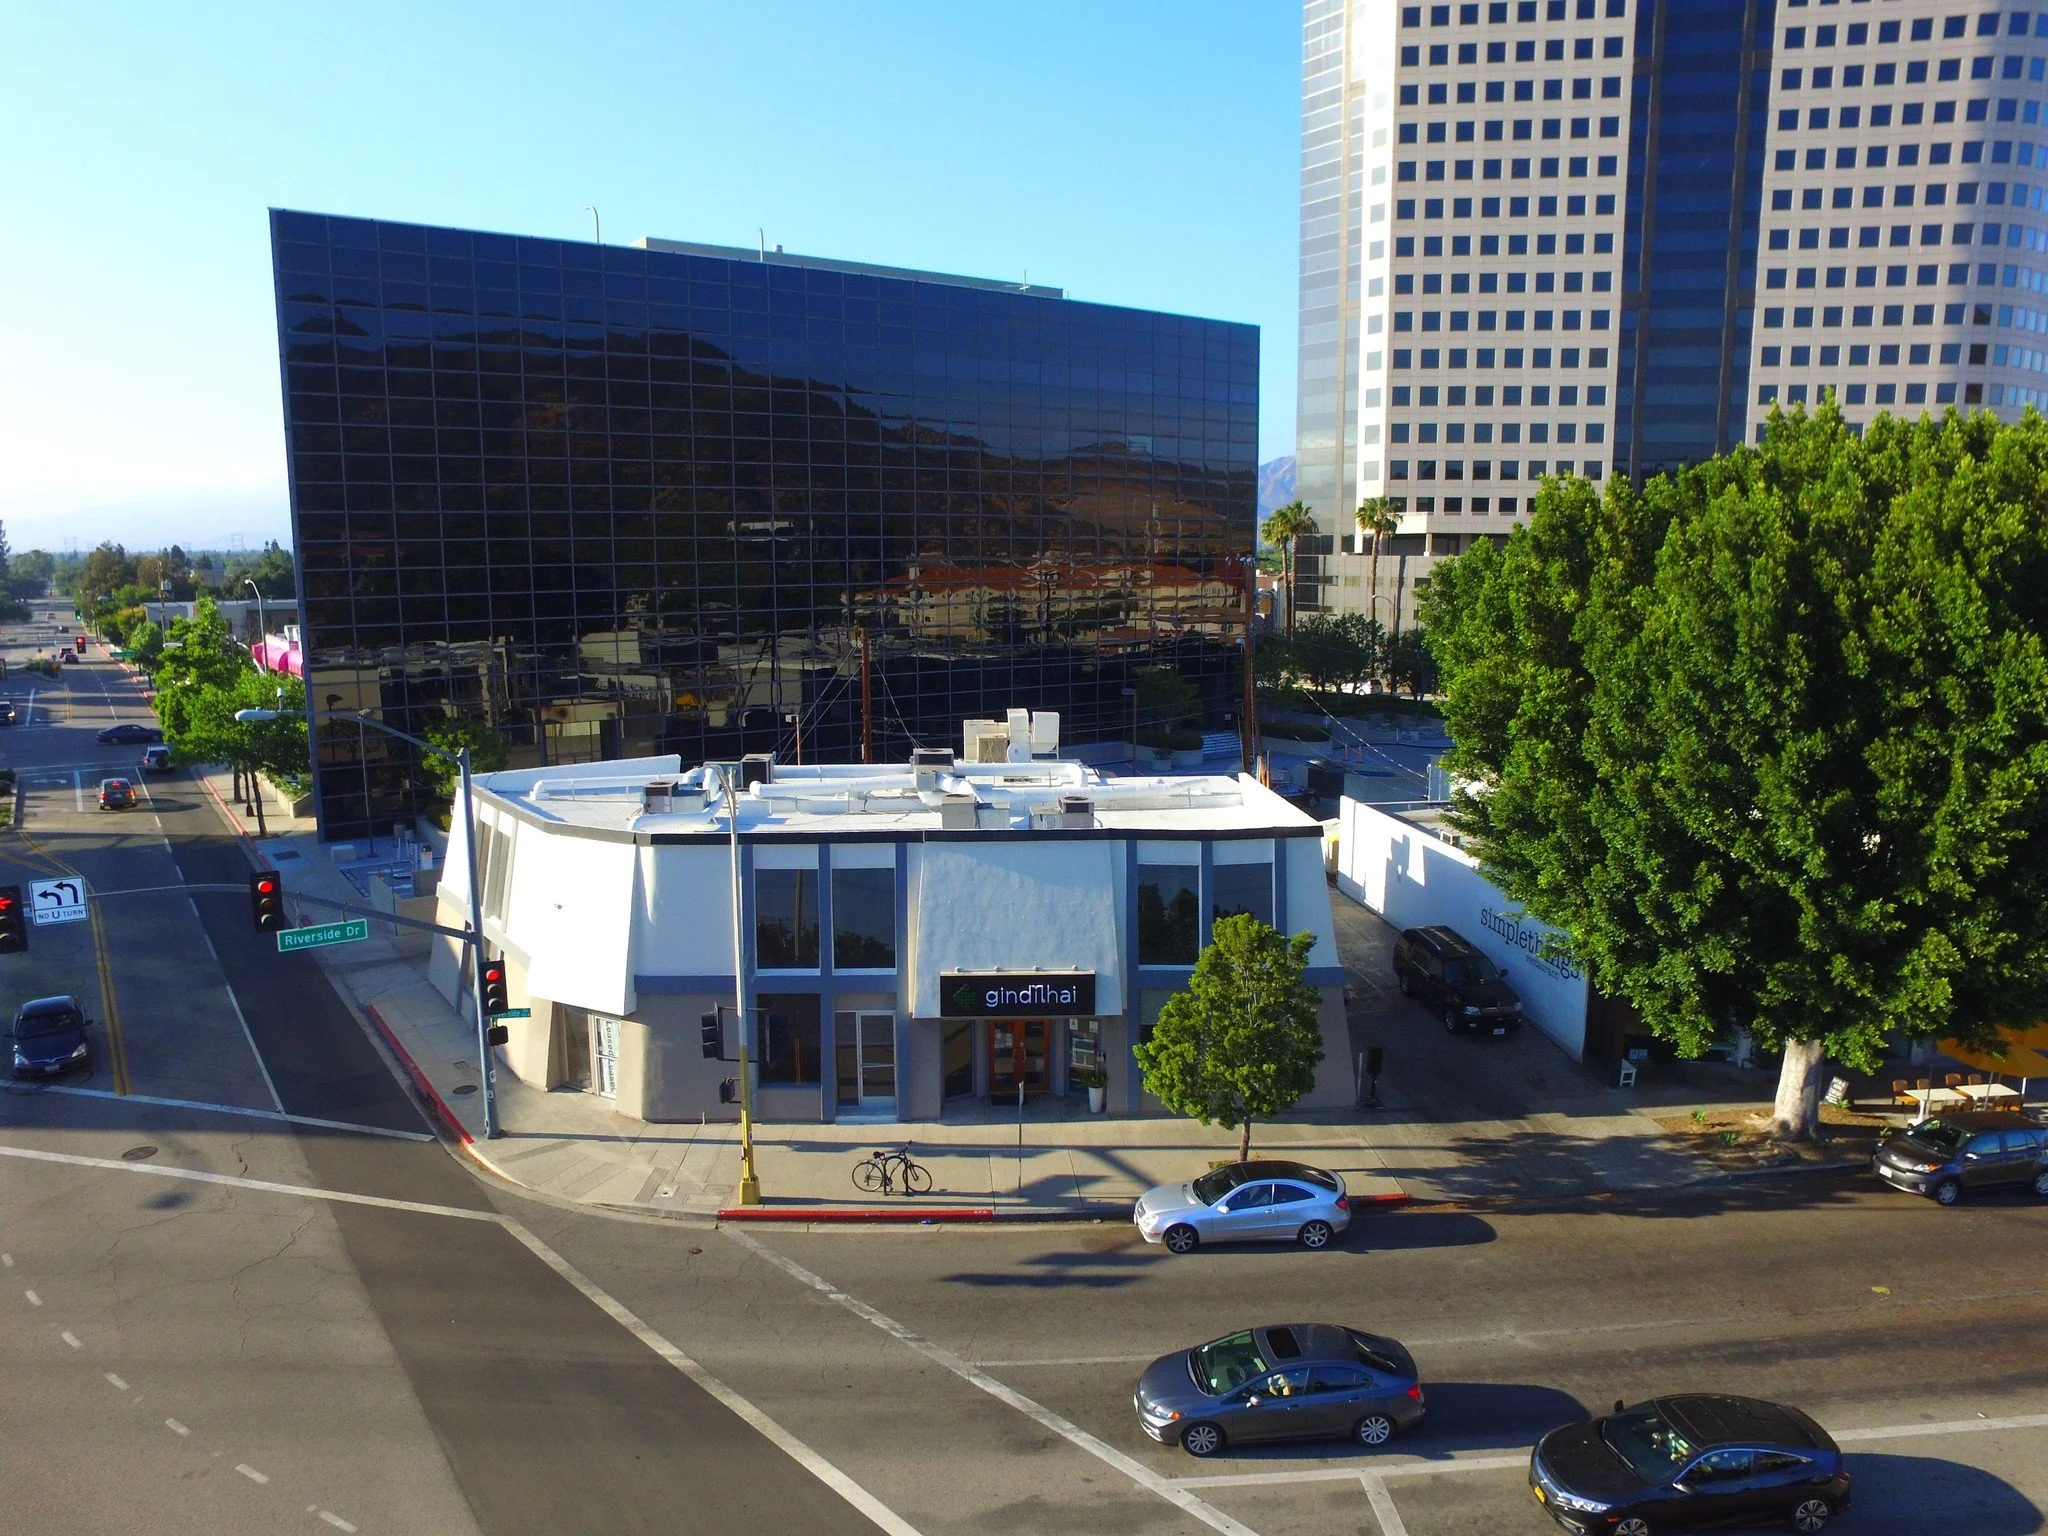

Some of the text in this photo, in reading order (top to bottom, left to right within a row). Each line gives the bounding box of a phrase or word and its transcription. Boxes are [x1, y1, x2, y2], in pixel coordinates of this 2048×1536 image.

[52, 911, 60, 919] U
[63, 909, 83, 917] TURN
[285, 926, 360, 946] Riverside Dr
